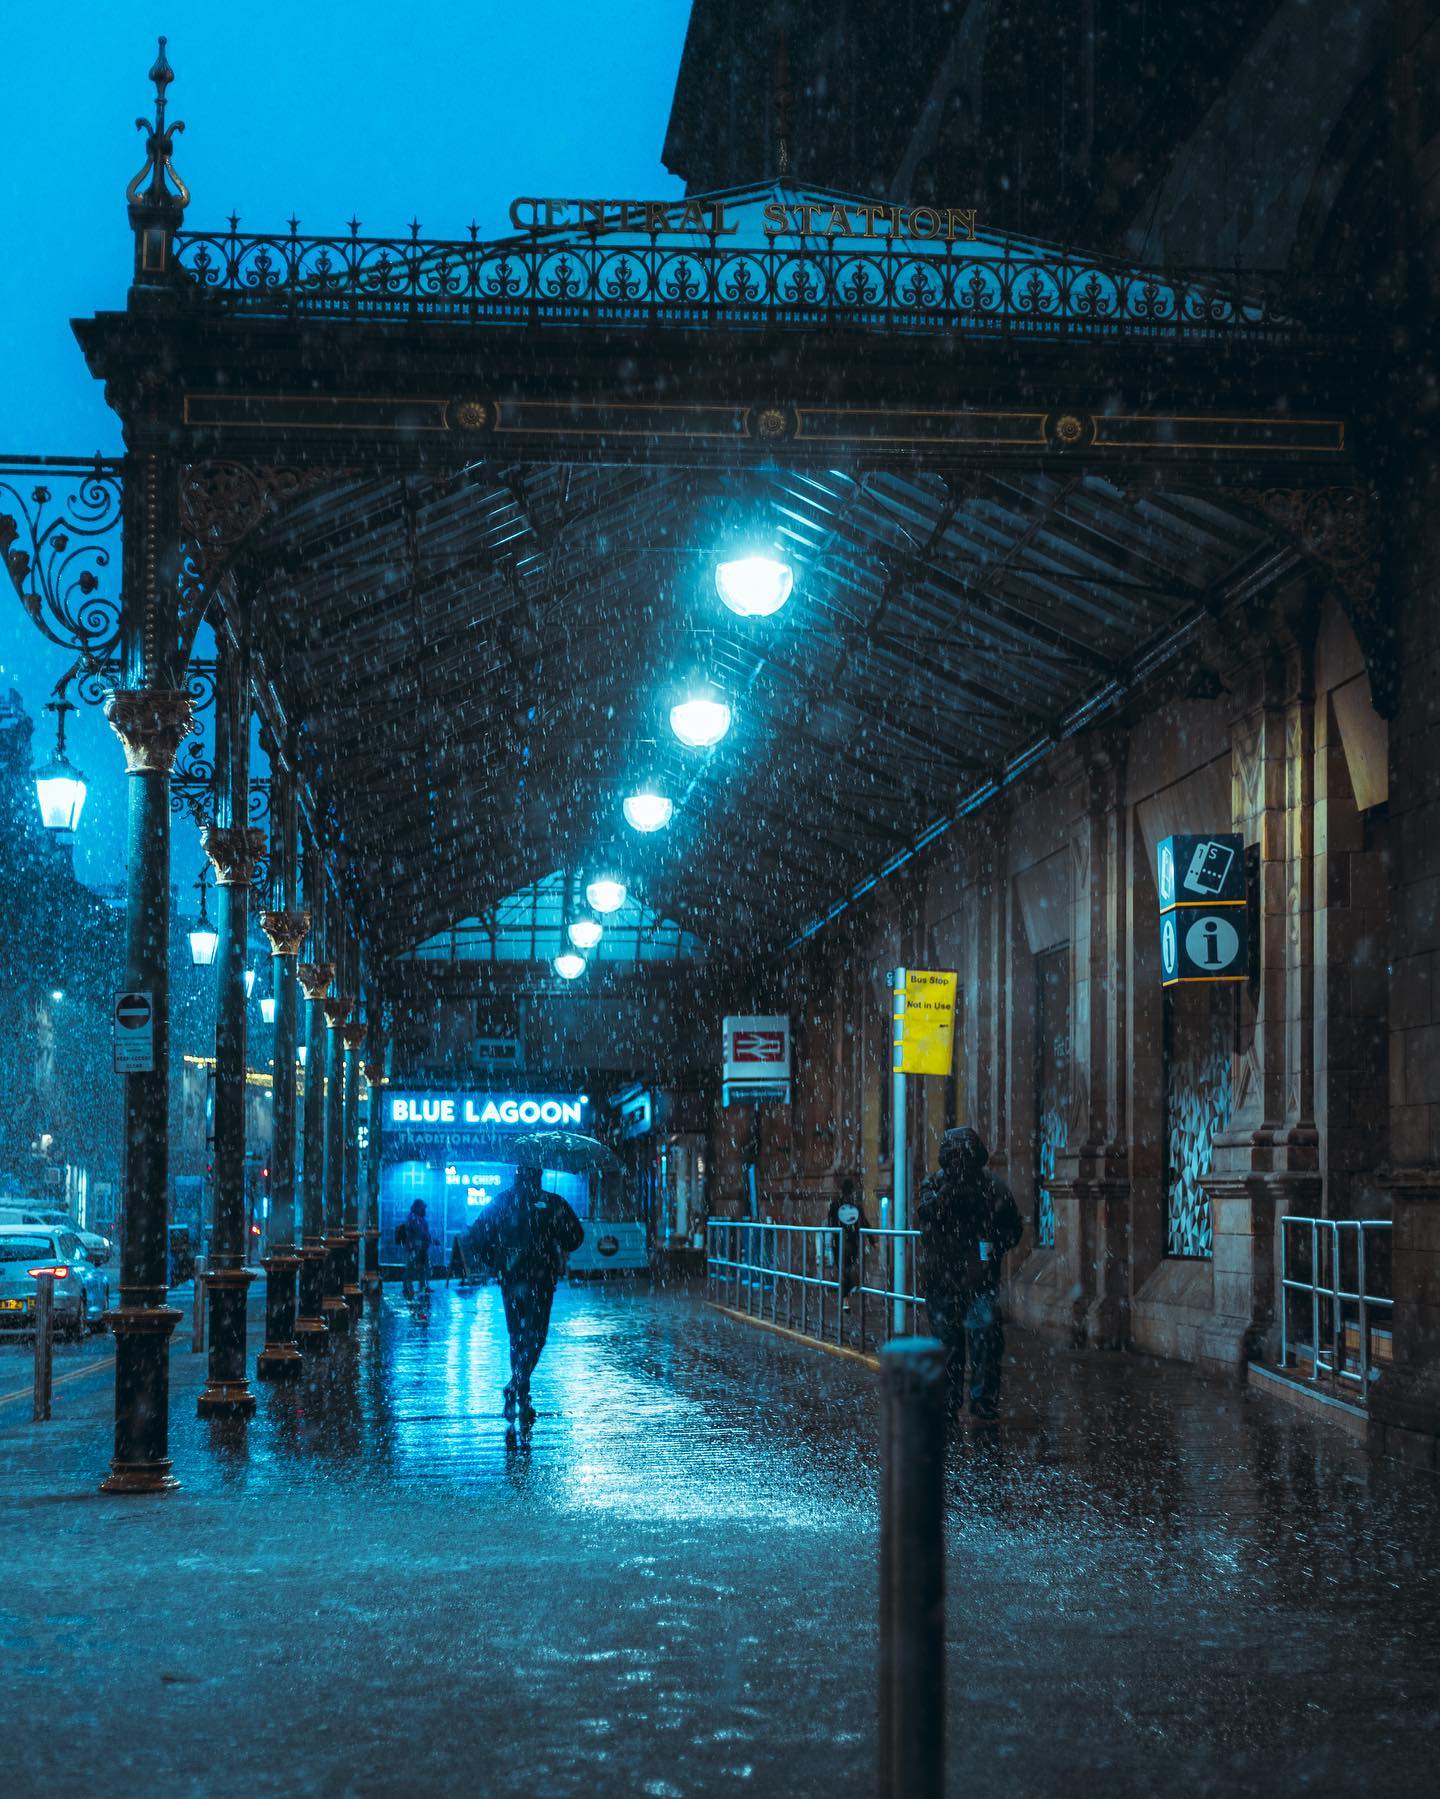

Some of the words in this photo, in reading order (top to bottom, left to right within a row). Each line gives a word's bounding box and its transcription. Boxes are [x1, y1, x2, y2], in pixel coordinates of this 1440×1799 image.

[509, 196, 738, 234] CENTRAL
[763, 204, 977, 241] STATION
[910, 975, 927, 984] Bus
[929, 976, 949, 986] Stop
[907, 1001, 922, 1009] Not
[934, 1002, 951, 1010] Use
[393, 1099, 455, 1122] BLUE
[464, 1100, 581, 1124] LAGOON
[400, 1133, 487, 1145] TRADITIONAL
